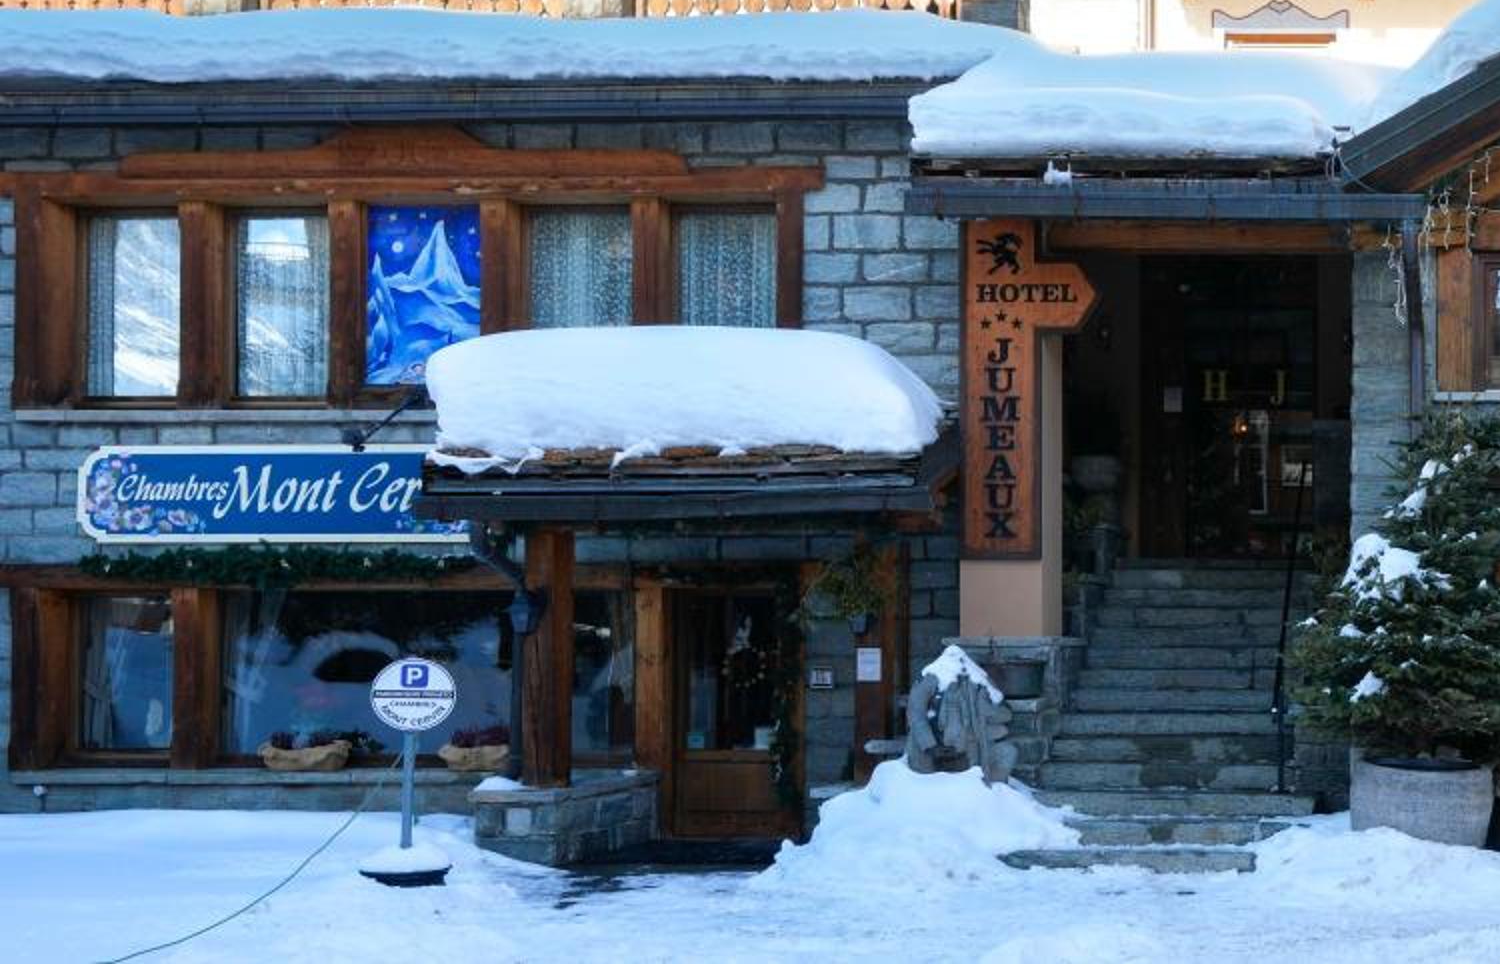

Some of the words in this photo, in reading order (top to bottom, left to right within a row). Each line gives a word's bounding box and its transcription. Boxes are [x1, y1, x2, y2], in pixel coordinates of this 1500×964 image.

[976, 283, 1078, 303] HOTEL
[980, 338, 1021, 538] JUMEAUX
[116, 473, 229, 503] Chambres
[213, 463, 342, 519] Mont
[405, 667, 423, 685] P
